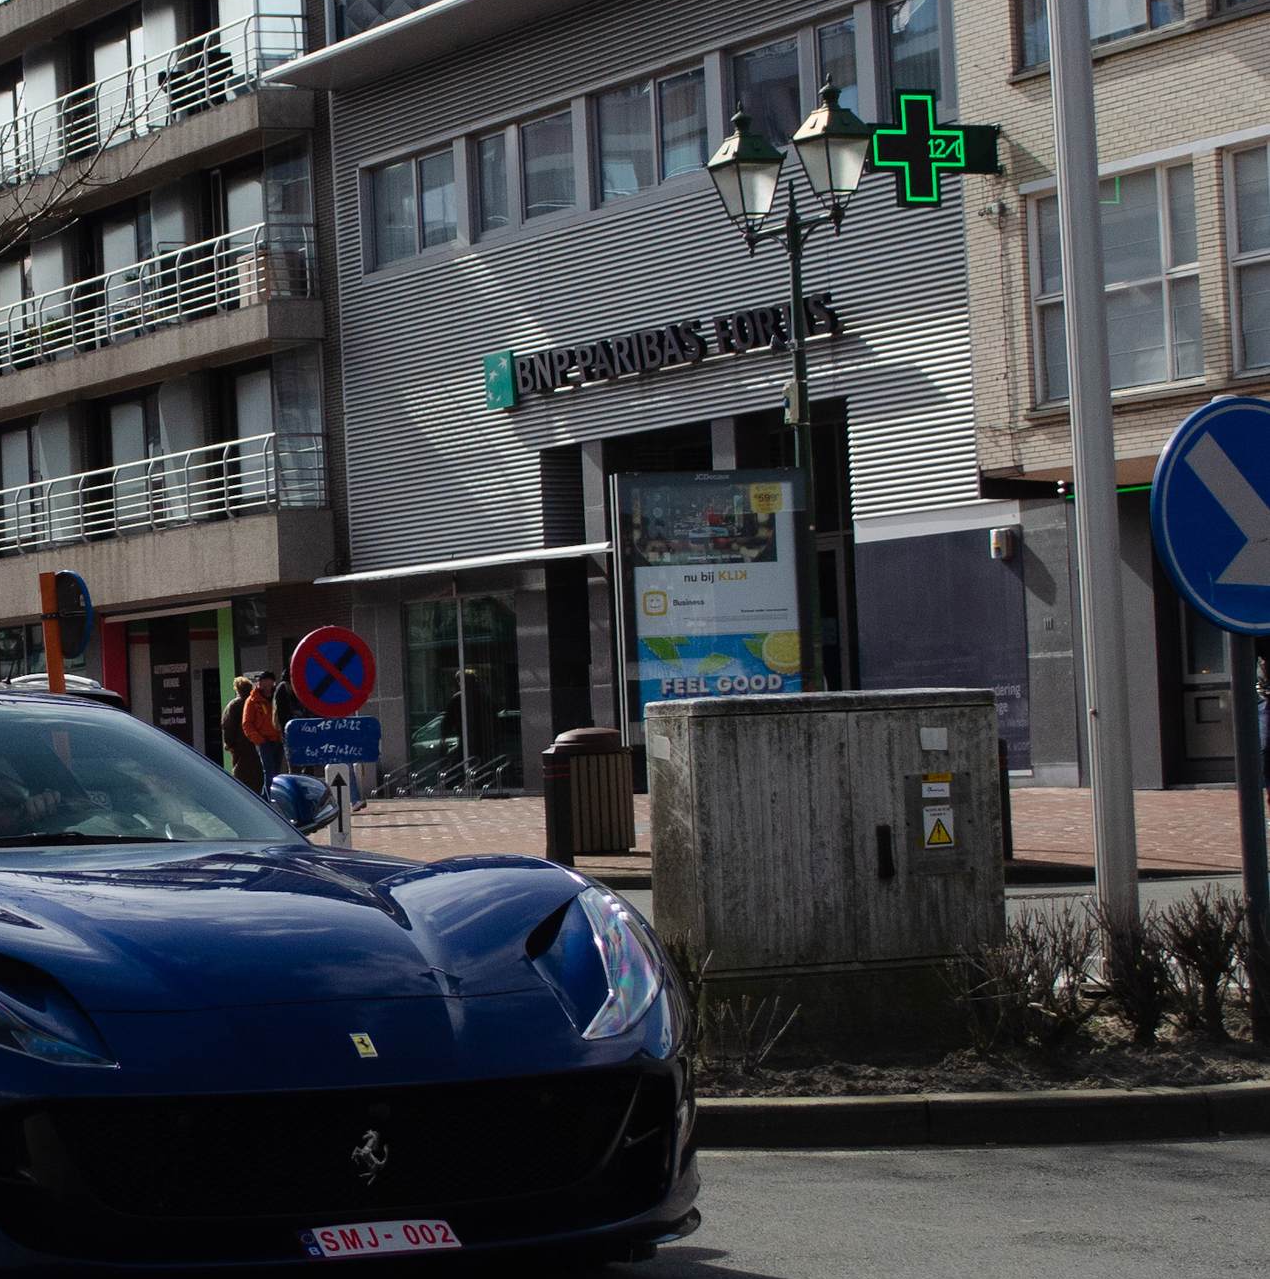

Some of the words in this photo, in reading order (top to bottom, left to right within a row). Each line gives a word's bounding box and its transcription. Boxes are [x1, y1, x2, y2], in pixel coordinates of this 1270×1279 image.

[515, 347, 570, 394] BNP
[574, 320, 706, 384] PARIBAS
[694, 473, 730, 481] JCDecaux
[701, 572, 715, 583] bij
[672, 599, 705, 607] Business
[660, 676, 711, 695] FEEL
[716, 673, 783, 694] GOOD
[320, 1223, 455, 1253] SMJ-002
[308, 1246, 321, 1256] B
